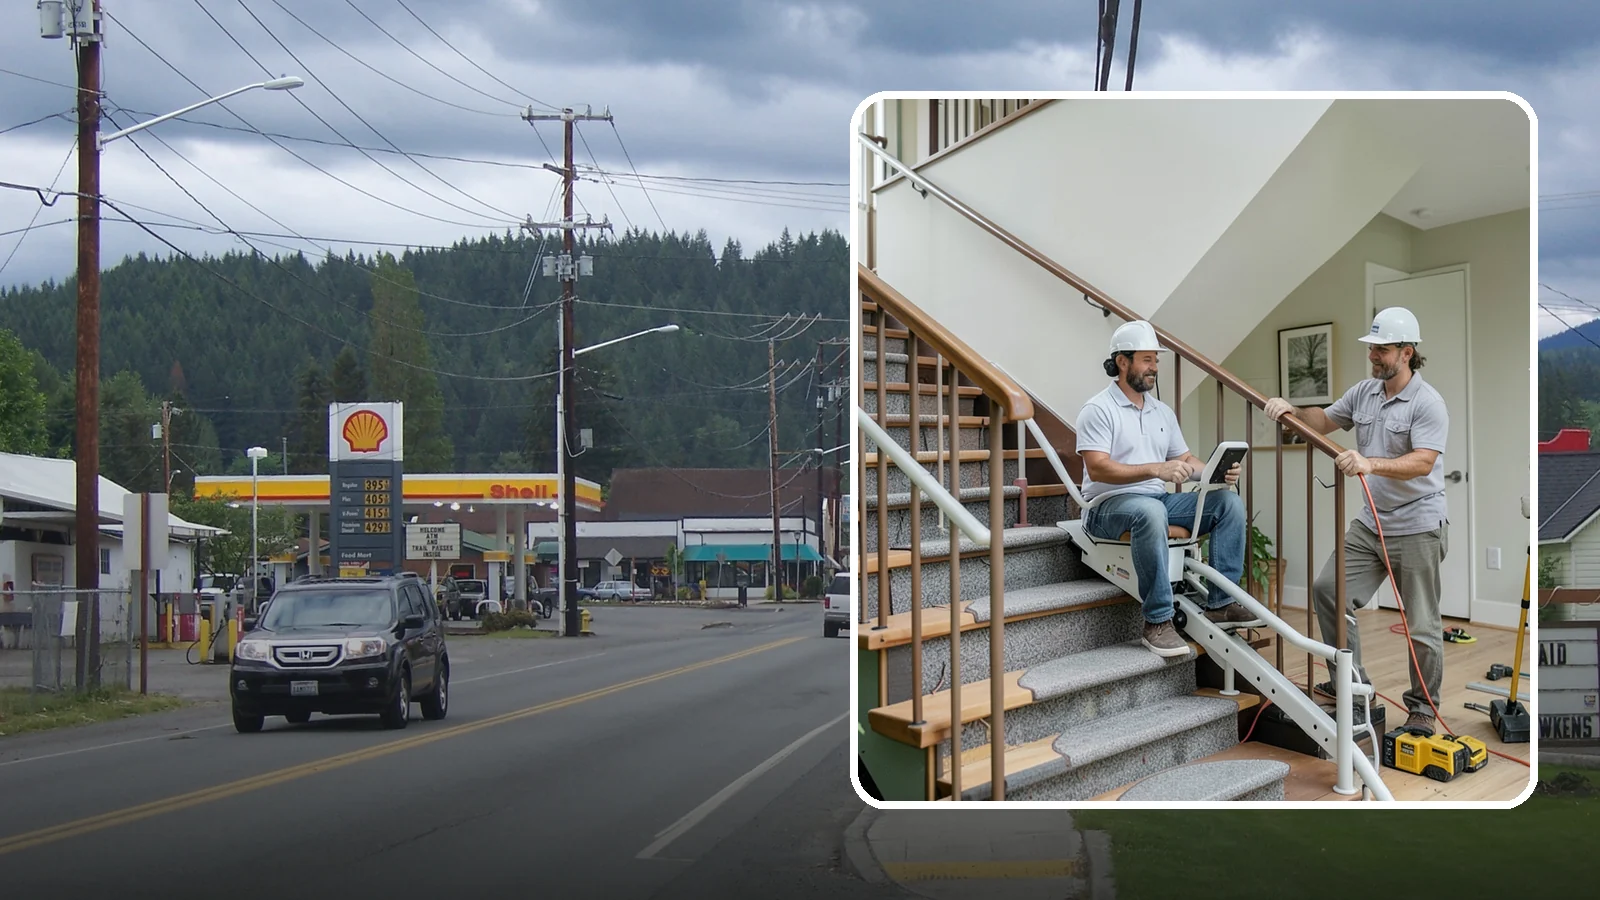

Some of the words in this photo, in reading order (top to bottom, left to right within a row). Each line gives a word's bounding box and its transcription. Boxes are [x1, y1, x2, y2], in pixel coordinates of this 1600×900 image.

[366, 480, 383, 490] 395
[490, 484, 547, 499] Shell
[366, 494, 383, 504] 405
[366, 508, 383, 518] 415
[366, 522, 383, 532] 429
